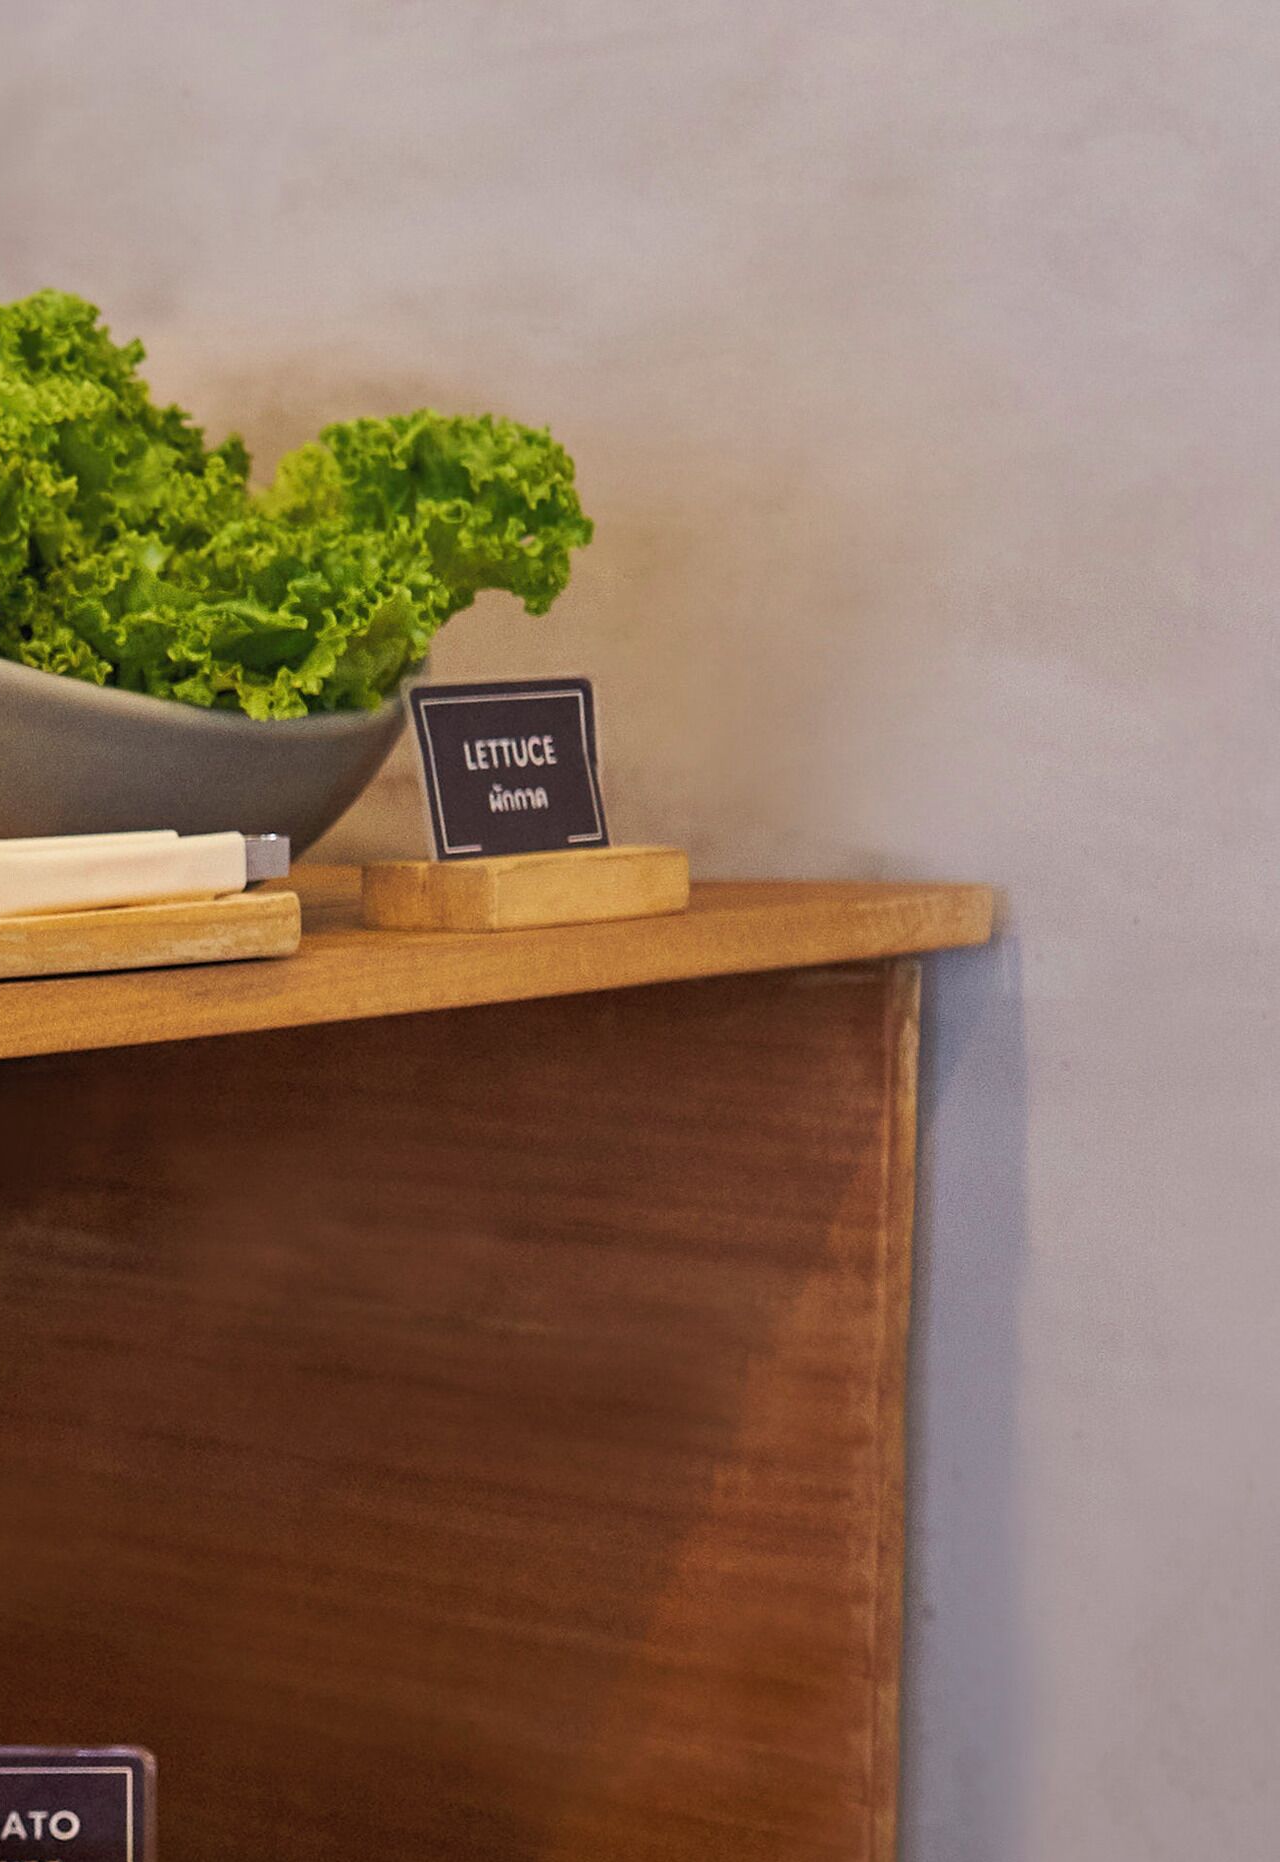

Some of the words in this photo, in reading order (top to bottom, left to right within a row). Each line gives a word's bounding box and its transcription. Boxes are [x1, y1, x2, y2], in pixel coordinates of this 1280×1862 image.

[463, 734, 558, 771] LETTUCE
[489, 783, 549, 813] ผักกาด
